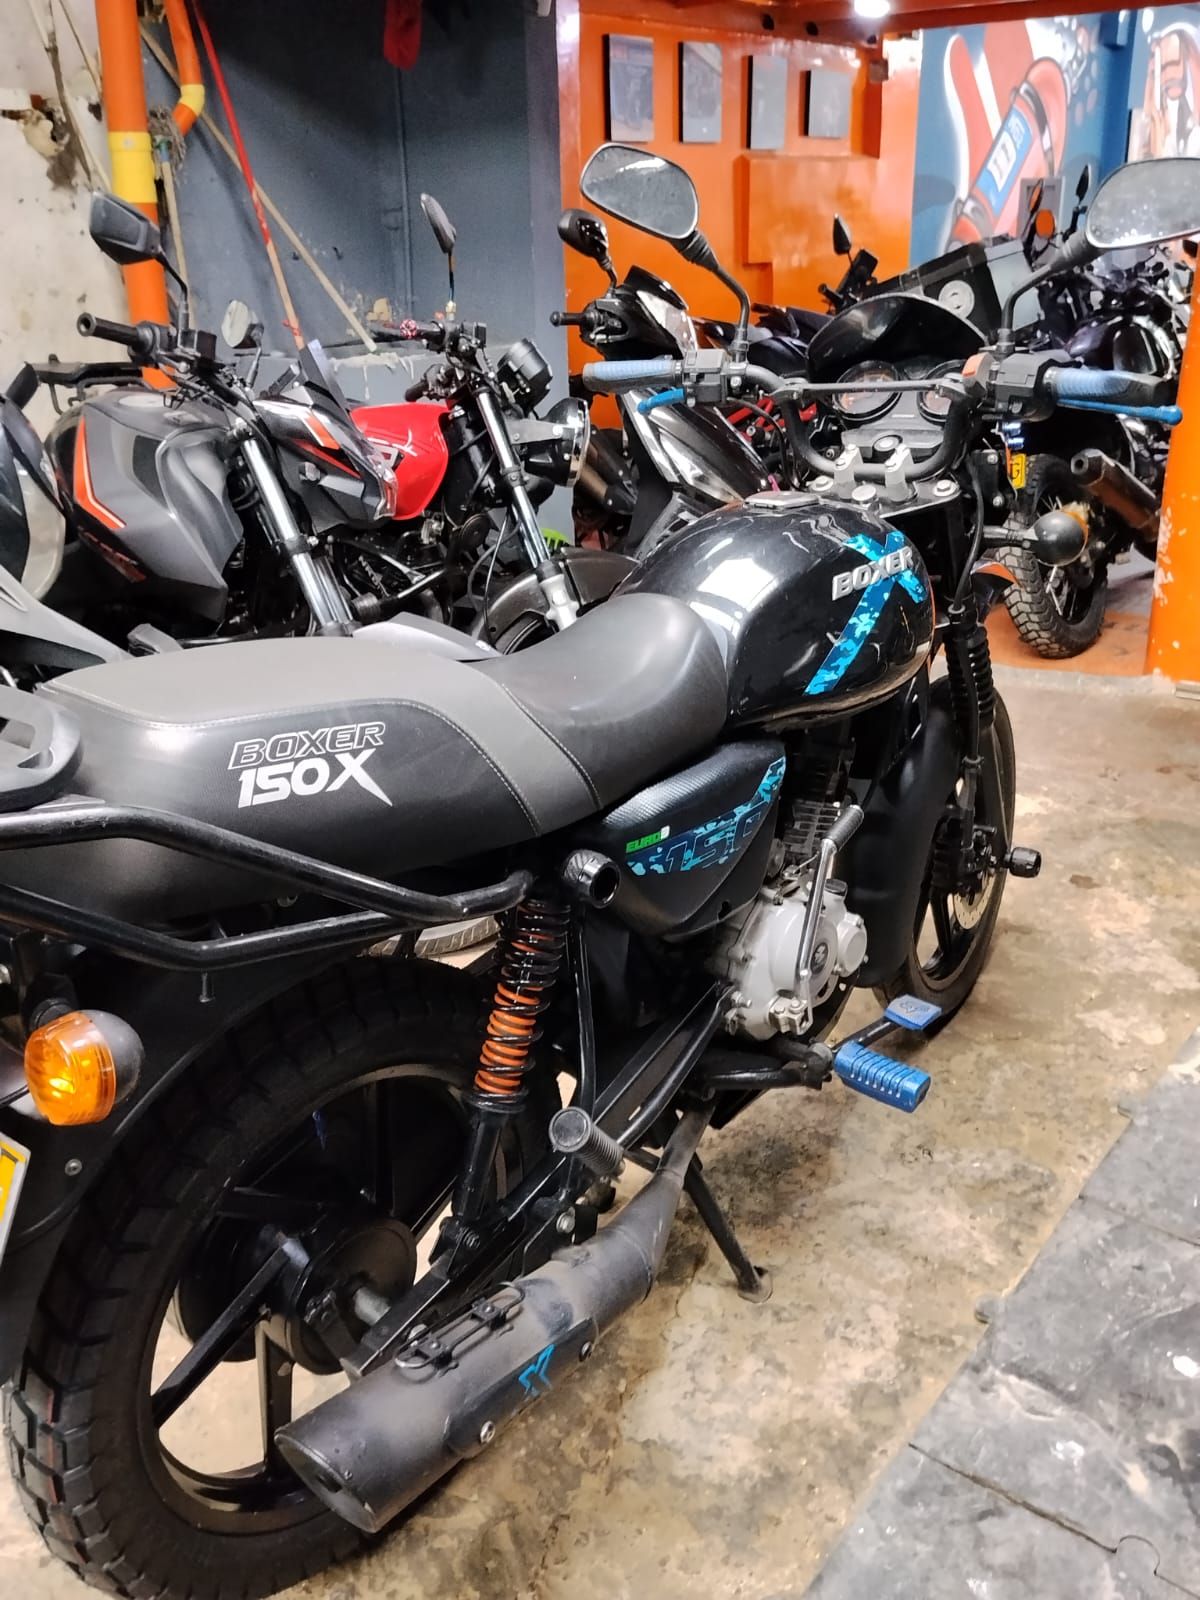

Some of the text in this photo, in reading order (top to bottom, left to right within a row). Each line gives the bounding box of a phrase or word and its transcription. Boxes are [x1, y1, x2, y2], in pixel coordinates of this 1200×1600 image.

[832, 546, 914, 600] BOXER
[227, 721, 386, 770] BOXER
[238, 748, 393, 808] 150X
